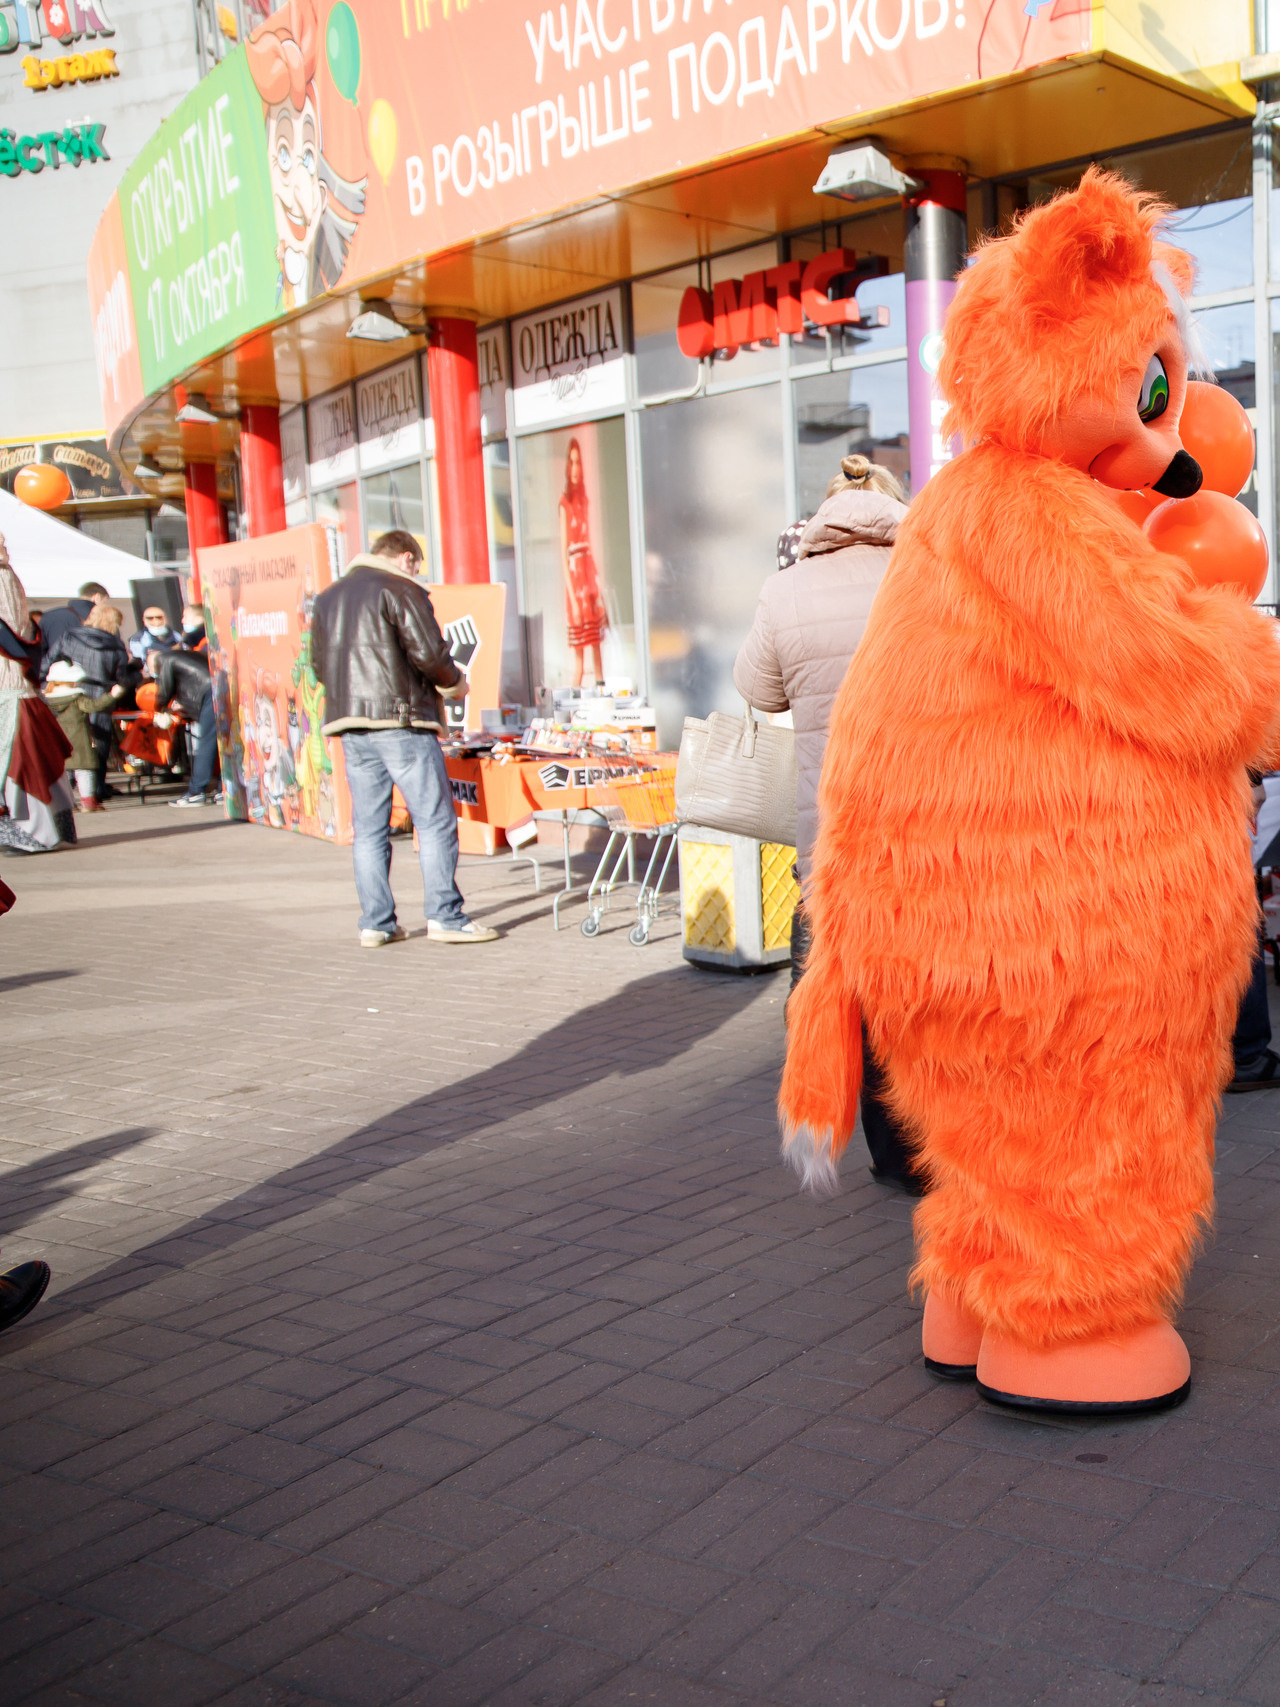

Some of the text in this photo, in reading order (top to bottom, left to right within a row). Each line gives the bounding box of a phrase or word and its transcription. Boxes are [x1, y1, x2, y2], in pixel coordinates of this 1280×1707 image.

[525, 0, 733, 84] УЧАСТ
[406, 155, 427, 216] В
[432, 59, 653, 206] РОЗЫГРЫШЕ
[131, 93, 240, 271] ОТКРЫТИЕ
[148, 277, 165, 362] 17
[169, 230, 247, 346] ОКТЯБРЯ
[518, 301, 618, 381] ОДЕЖДА
[361, 368, 416, 434] ОДЕЖДА
[448, 779, 478, 804] МАК
